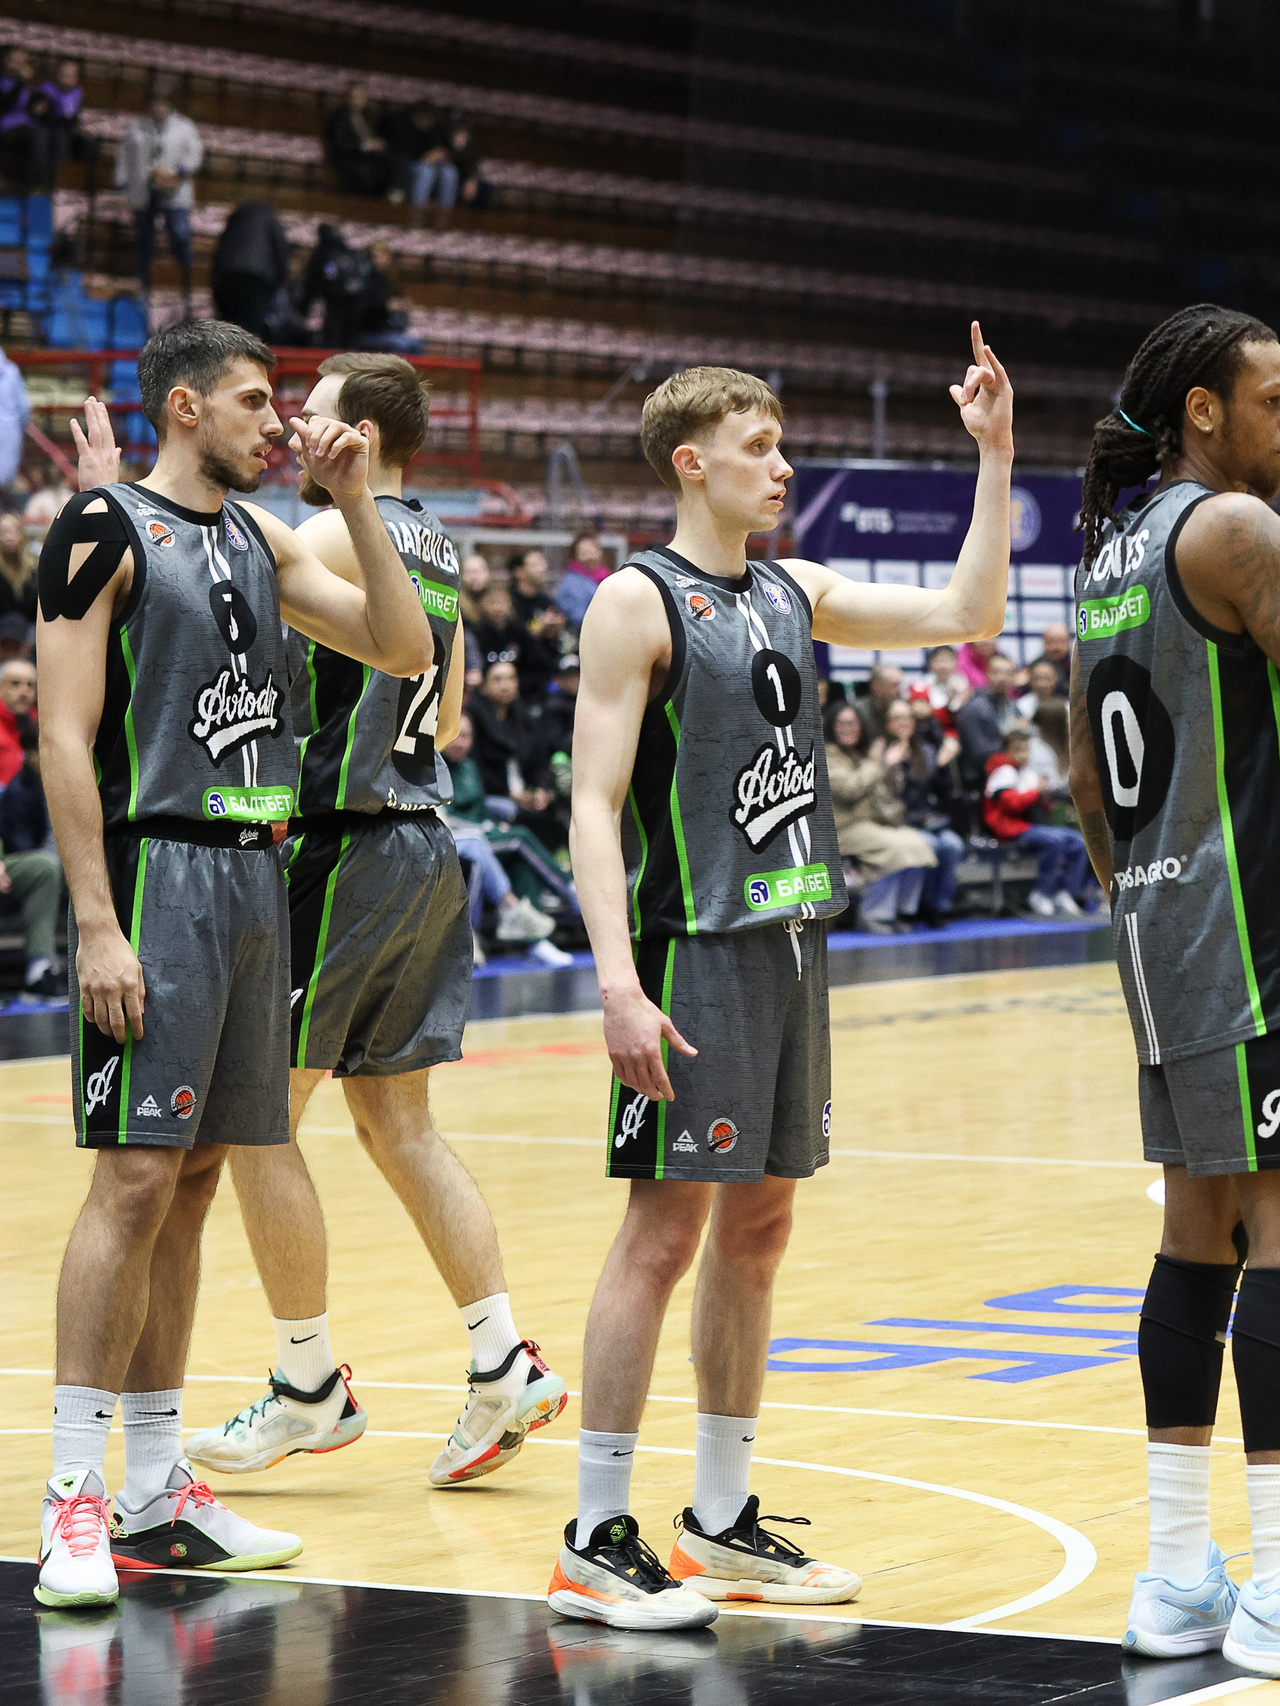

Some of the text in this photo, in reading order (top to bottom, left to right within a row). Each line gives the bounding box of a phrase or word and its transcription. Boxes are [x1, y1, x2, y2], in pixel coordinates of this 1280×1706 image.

[766, 662, 787, 712] 1
[1101, 690, 1145, 808] 0
[136, 1106, 162, 1118] PEAK
[673, 1142, 699, 1154] PEAK
